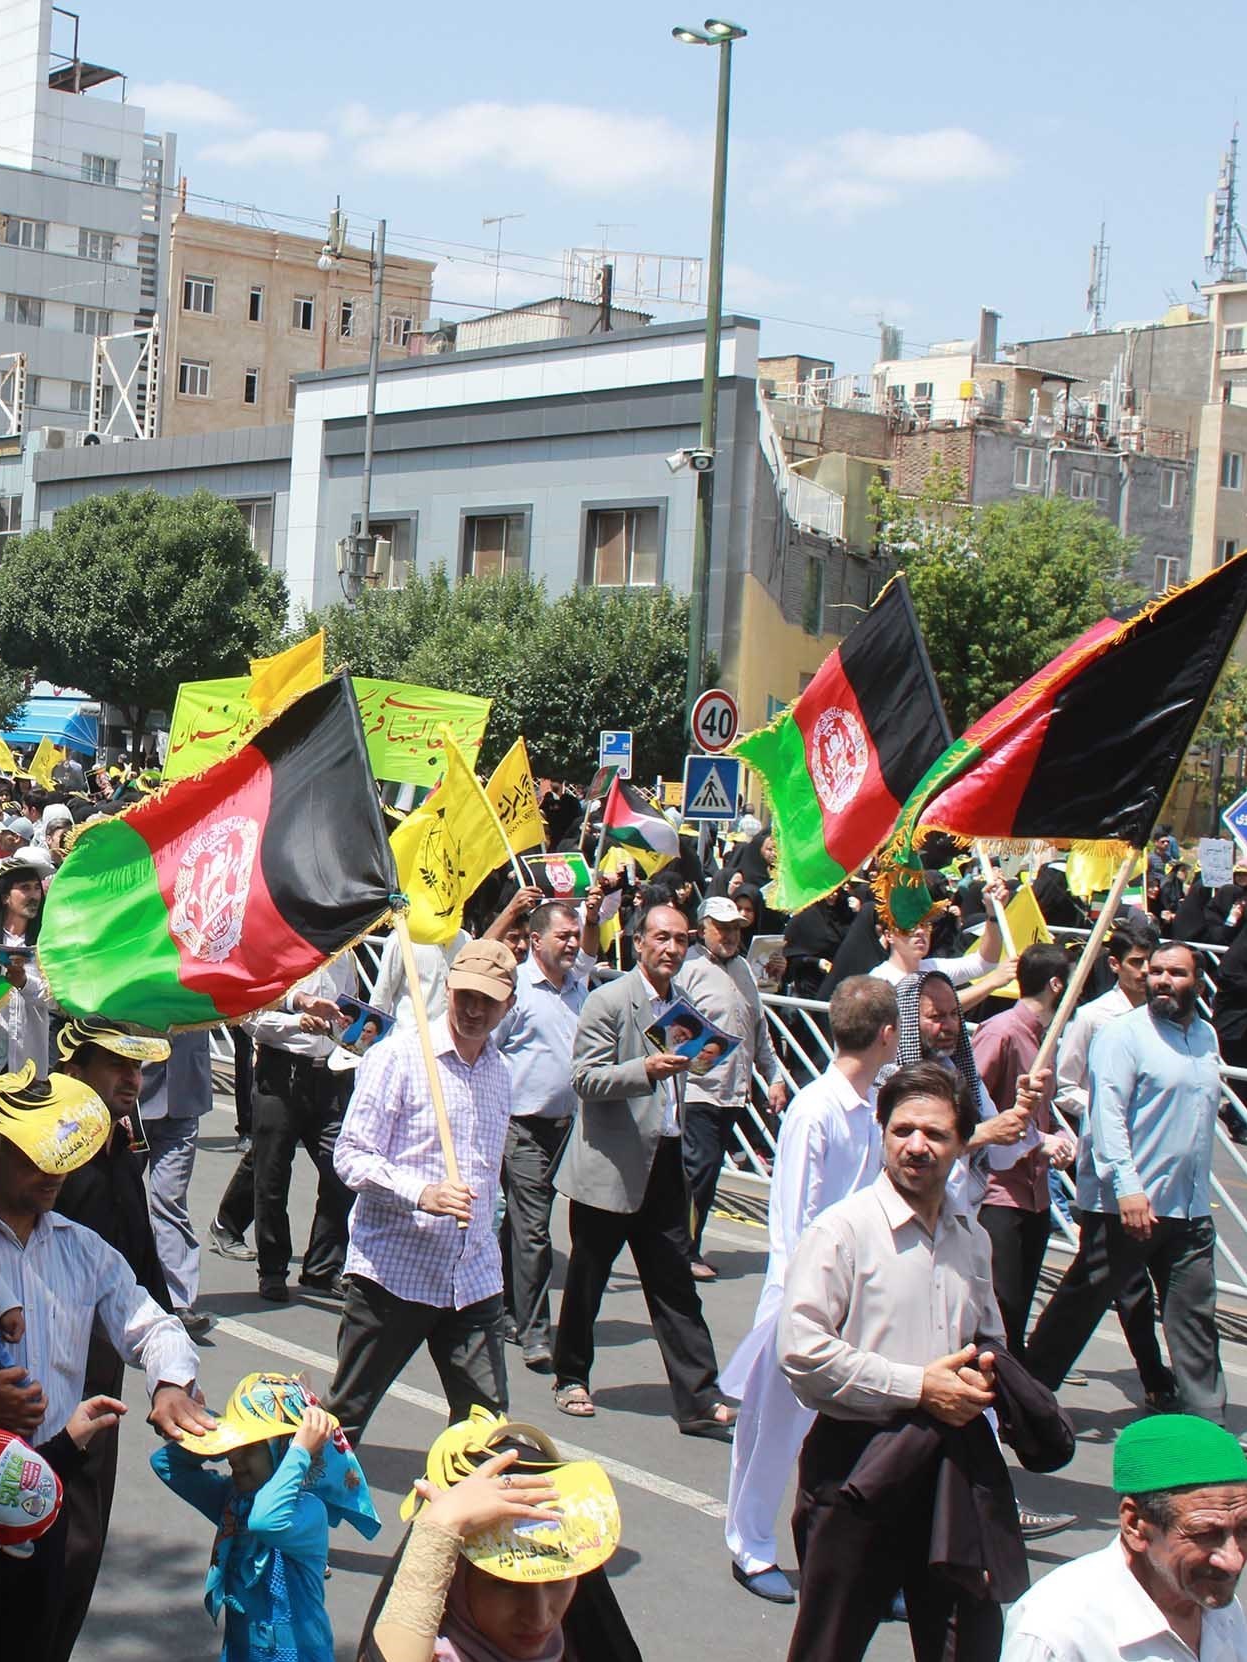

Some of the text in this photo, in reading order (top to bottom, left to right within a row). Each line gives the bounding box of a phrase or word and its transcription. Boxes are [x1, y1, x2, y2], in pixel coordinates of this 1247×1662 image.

[701, 706, 733, 740] 40
[603, 734, 616, 753] P
[558, 1540, 570, 1559] را
